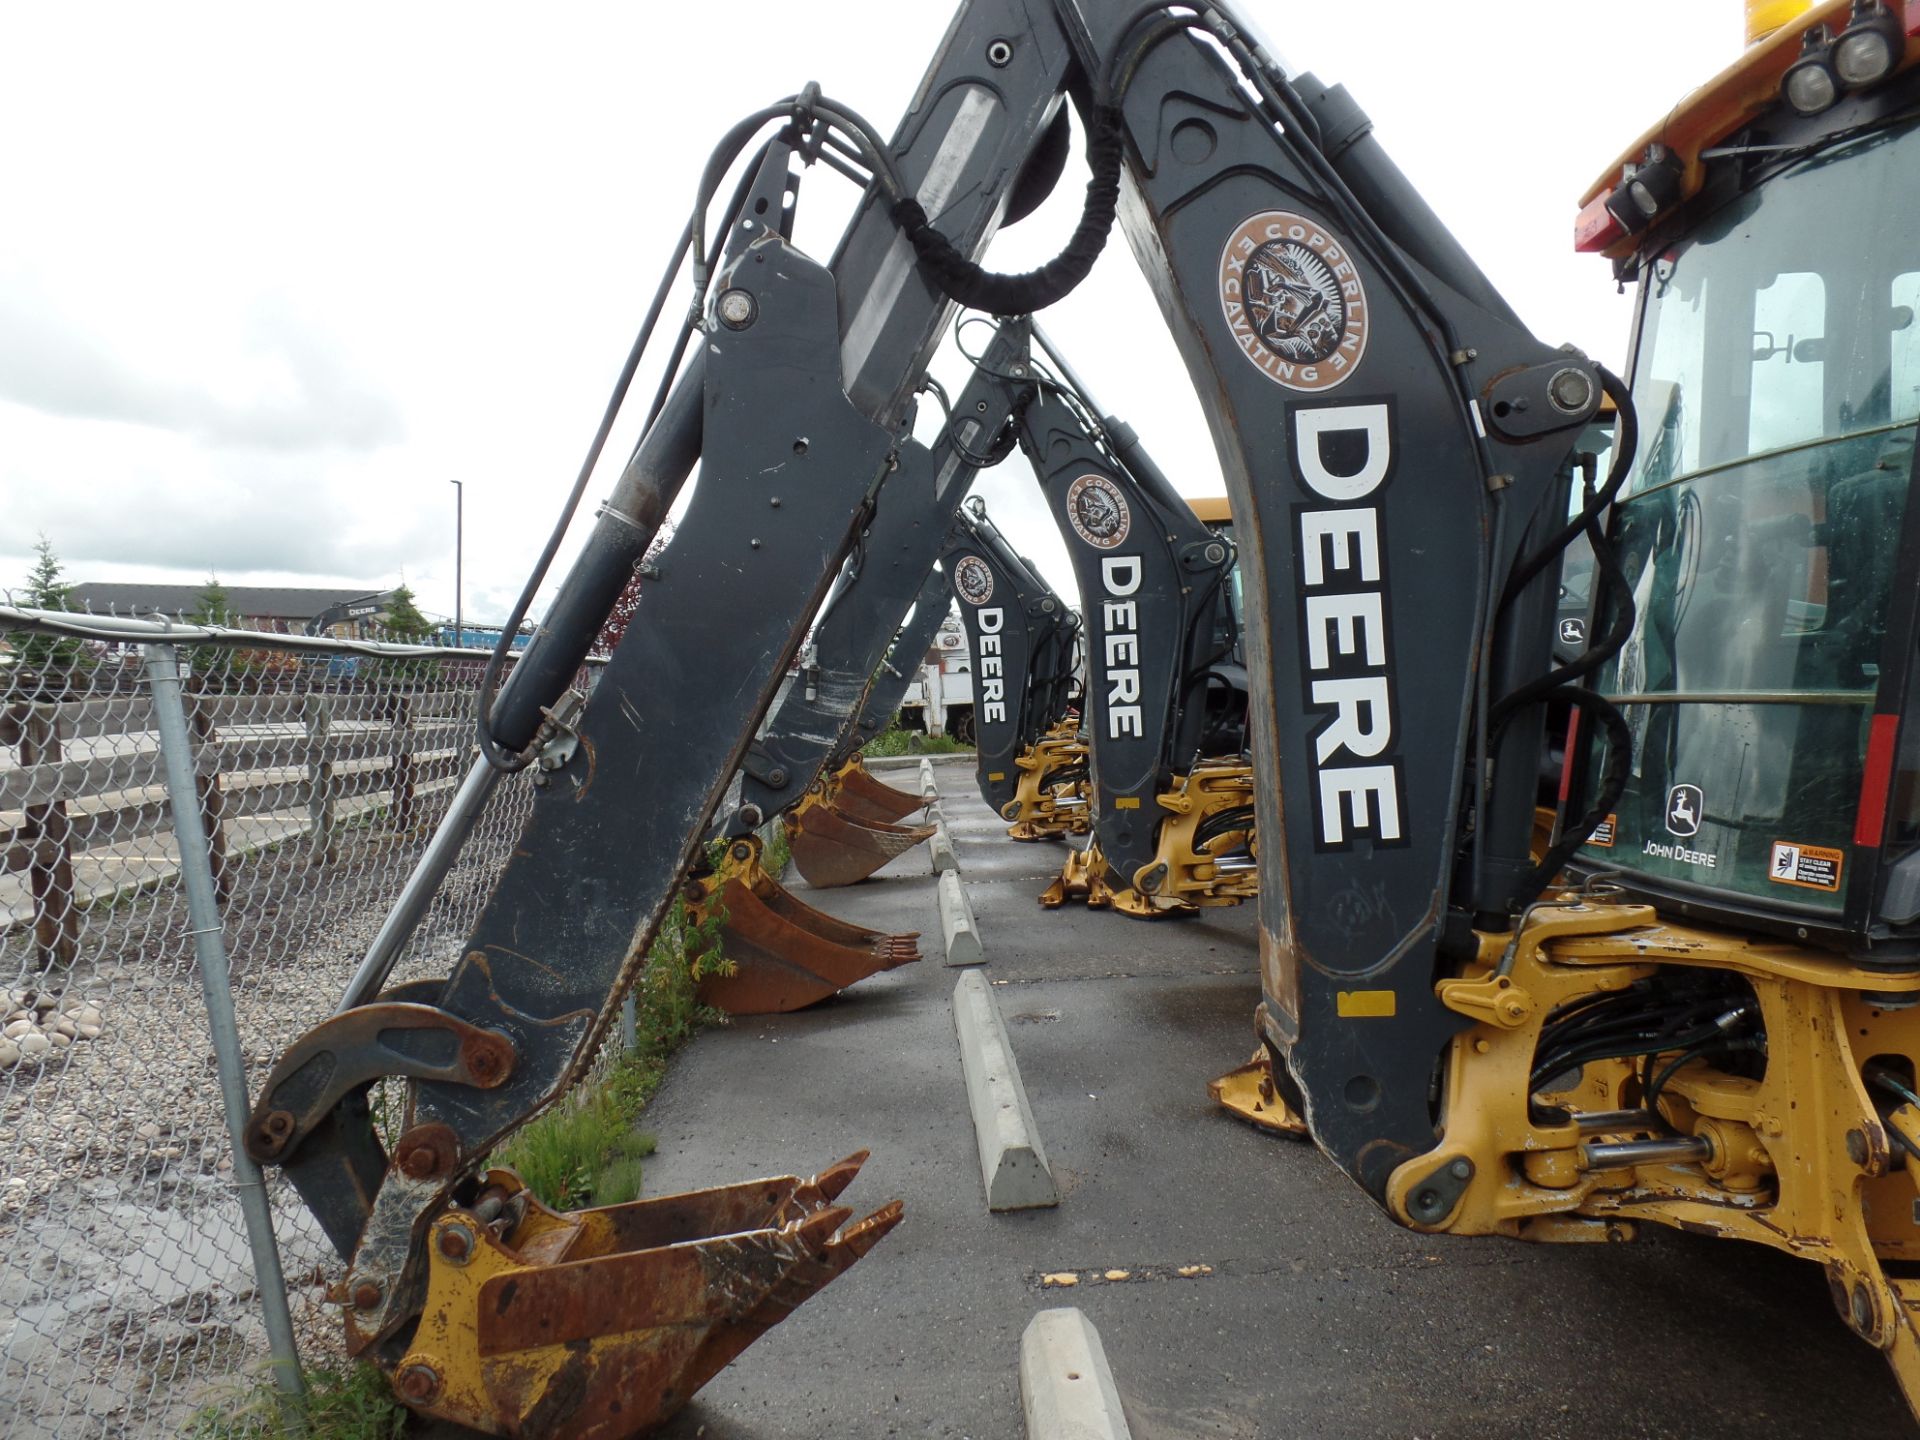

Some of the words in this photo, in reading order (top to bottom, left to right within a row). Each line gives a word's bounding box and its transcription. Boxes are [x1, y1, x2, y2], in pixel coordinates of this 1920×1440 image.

[1224, 236, 1318, 381] EXCAVATING
[1265, 223, 1362, 371] COPPERLINE
[1070, 485, 1110, 545] EXCAVATING
[1086, 480, 1127, 540] COPPERLINE
[978, 607, 1006, 723] DEERE
[1102, 556, 1142, 738] DEERE
[1295, 404, 1400, 843] DEERE
[1642, 839, 1673, 859] JOHN
[1674, 845, 1716, 868] DEERE
[1799, 857, 1813, 865] STAY
[1808, 849, 1840, 859] WARNING
